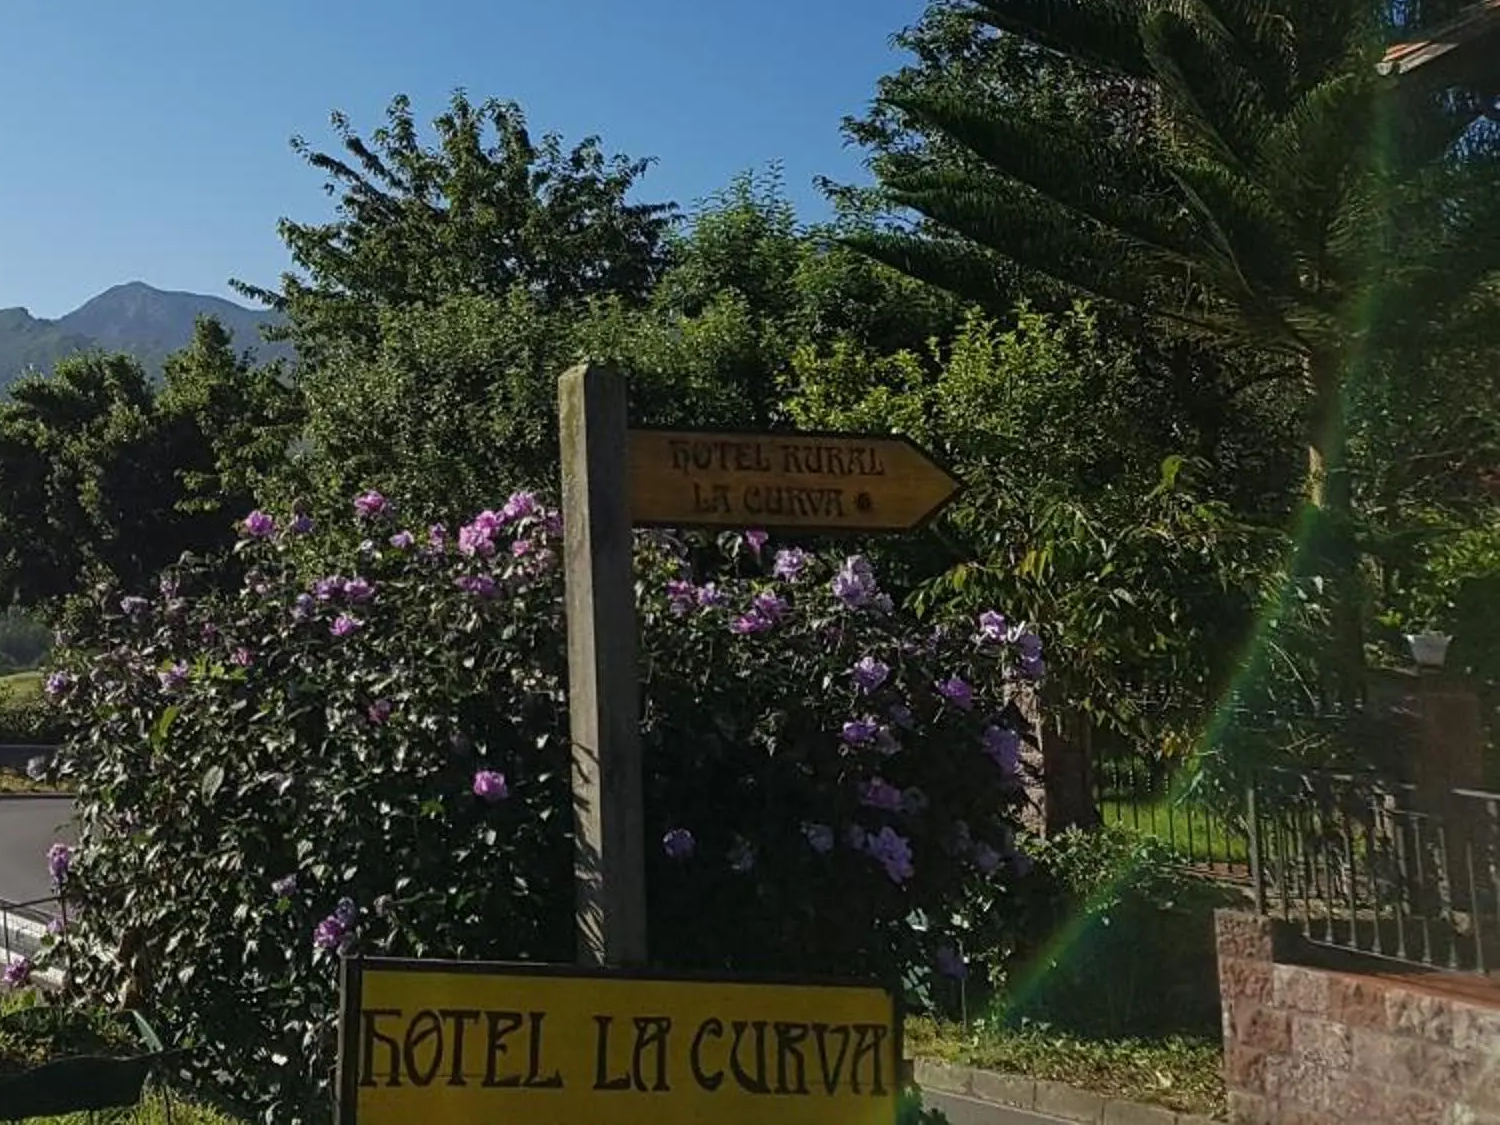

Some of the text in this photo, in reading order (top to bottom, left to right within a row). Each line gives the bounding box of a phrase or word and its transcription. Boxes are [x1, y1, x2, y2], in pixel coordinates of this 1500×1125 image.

[668, 440, 886, 476] HOTEL RURAL
[693, 481, 844, 517] LA CURVA
[359, 1009, 888, 1096] HOTEL LA CURVA
